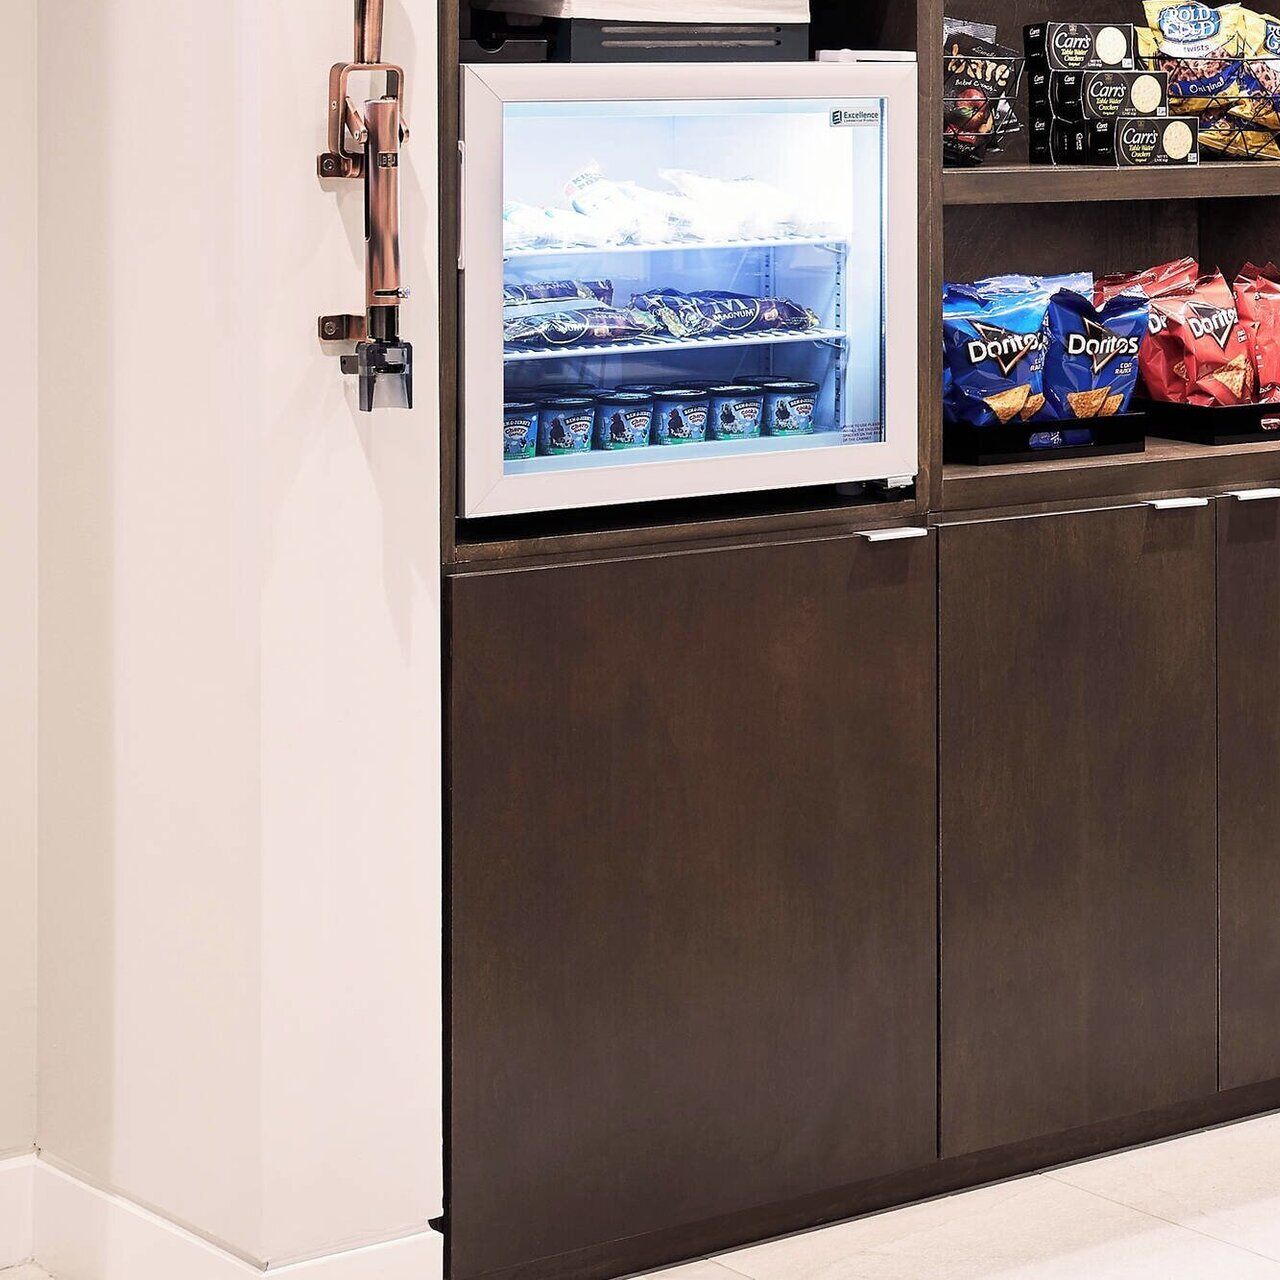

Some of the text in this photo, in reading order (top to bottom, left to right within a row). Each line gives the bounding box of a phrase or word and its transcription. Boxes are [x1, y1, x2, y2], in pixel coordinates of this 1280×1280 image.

[1055, 32, 1092, 49] Carr's
[1090, 81, 1127, 98] Carr's
[1189, 76, 1225, 95] Original
[844, 111, 879, 119] Excellence
[1123, 128, 1159, 144] Carr's
[1068, 333, 1139, 355] Doritos
